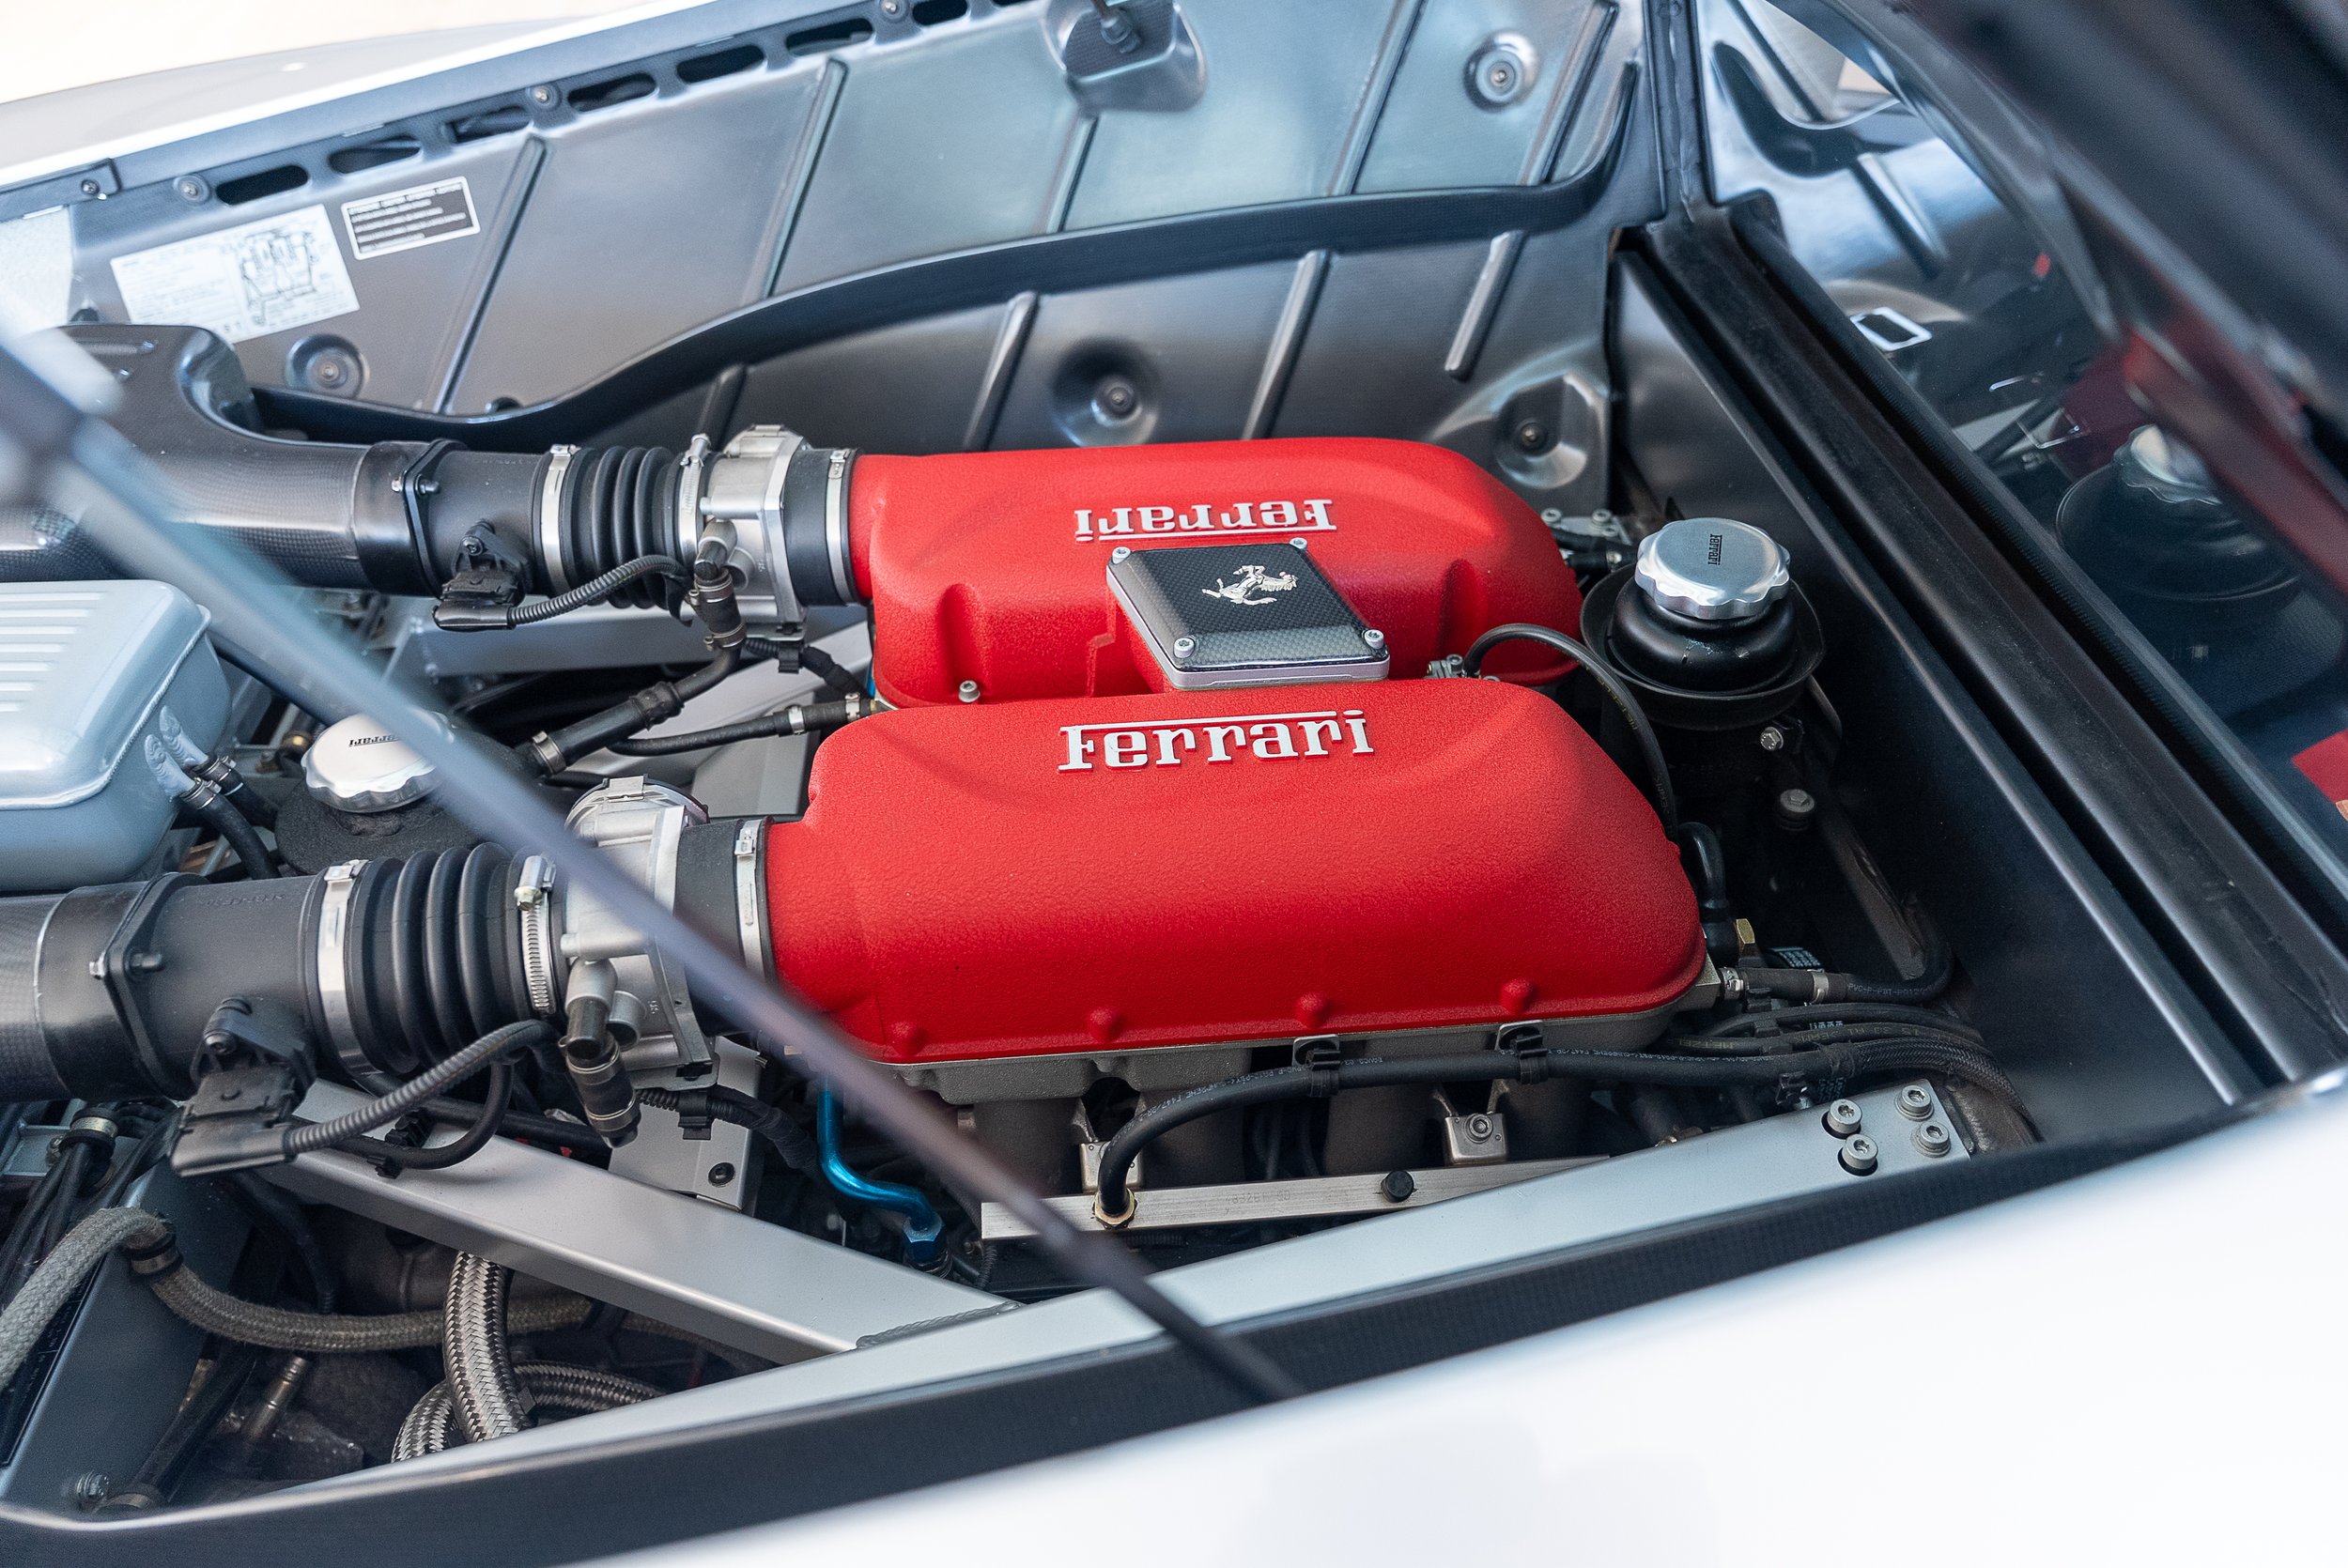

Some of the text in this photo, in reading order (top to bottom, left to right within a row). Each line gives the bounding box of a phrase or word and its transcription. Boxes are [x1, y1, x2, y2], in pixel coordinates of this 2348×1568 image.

[1074, 499, 1336, 542] Ferrari
[1708, 533, 1722, 566] Ferrari
[348, 734, 401, 747] errari
[1058, 710, 1374, 773] Ferrari
